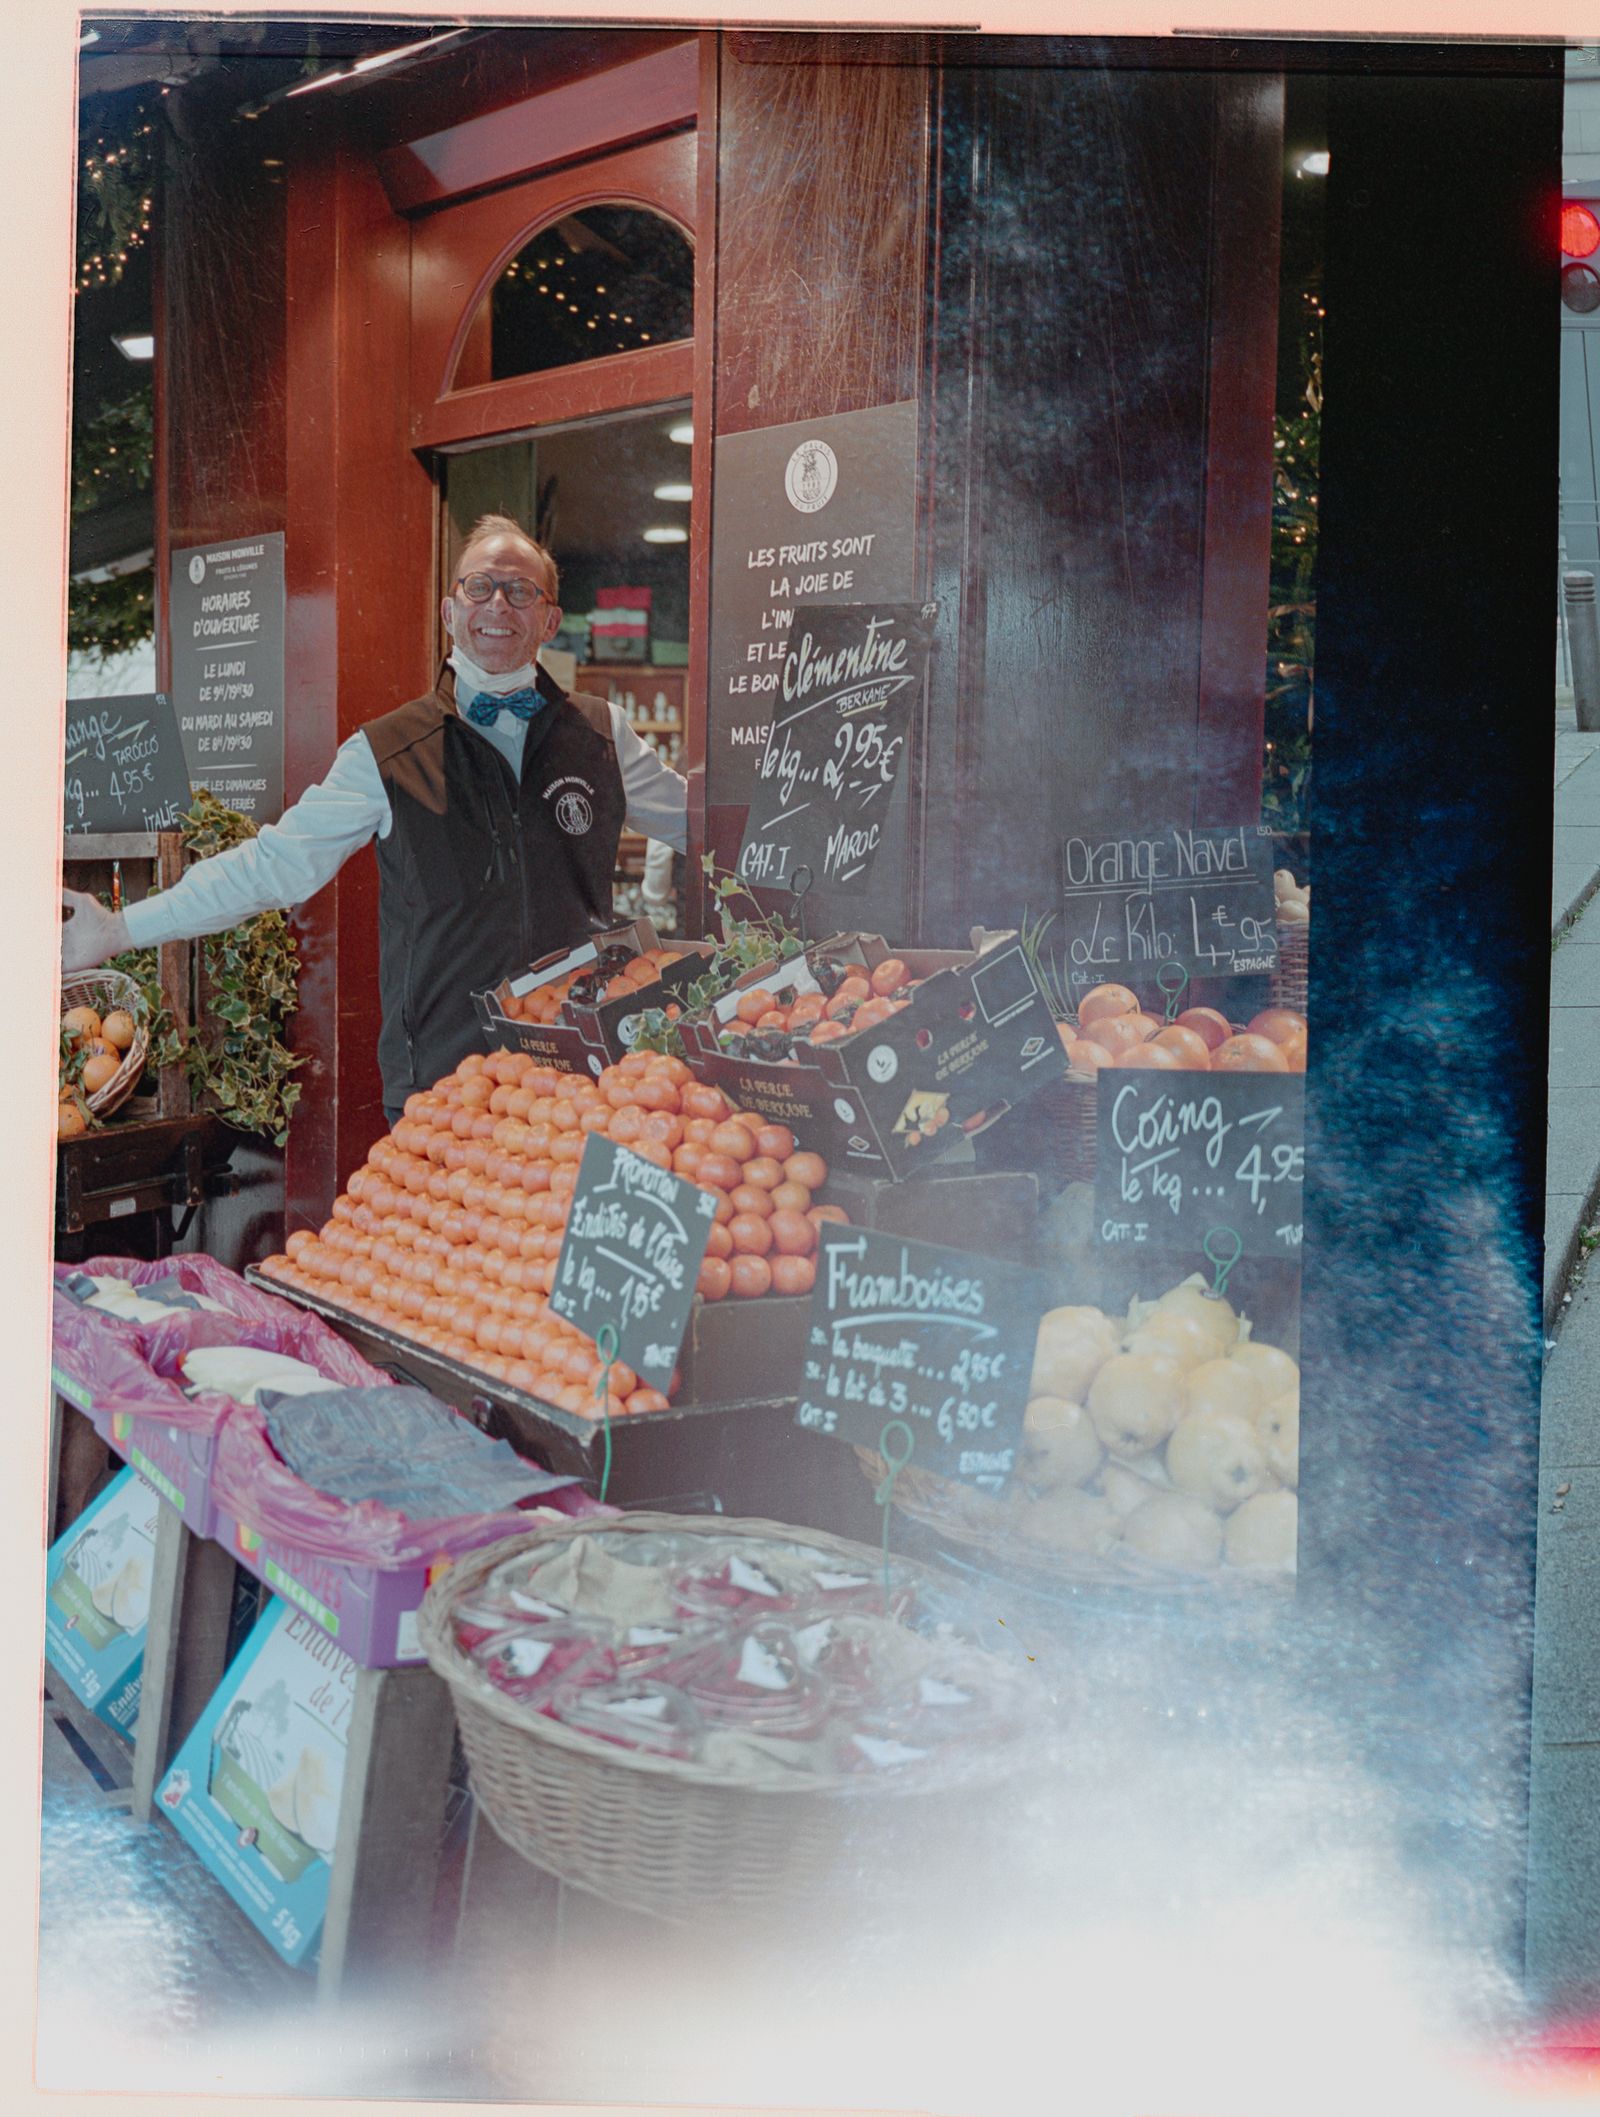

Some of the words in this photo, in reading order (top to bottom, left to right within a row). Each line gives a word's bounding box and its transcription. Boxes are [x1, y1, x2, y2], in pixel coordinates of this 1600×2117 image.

[206, 551, 231, 563] MAISON
[232, 544, 264, 558] MONVILLE
[748, 547, 775, 568] LES
[779, 541, 828, 567] FRUITS
[832, 534, 875, 559] SONT
[770, 578, 790, 598] LA
[794, 573, 828, 595] JOIE
[833, 570, 854, 590] DE
[201, 590, 251, 613] HORAIRES
[193, 613, 260, 637] D'OUVERTURE
[747, 642, 766, 662] ET
[768, 641, 787, 660] LE
[783, 616, 908, 703] Clémentine
[204, 664, 216, 679] LE
[218, 661, 247, 676] LUNDI
[200, 686, 210, 701] DE
[728, 674, 749, 695] LE
[182, 716, 193, 731] DU
[196, 714, 222, 731] MARDI
[224, 712, 237, 730] AU
[239, 710, 273, 728] SAMEDI
[112, 734, 159, 766] TAROCCO
[198, 736, 210, 752] DE
[761, 719, 780, 779] le
[823, 722, 903, 800] 2,95€
[110, 762, 154, 815] 4,95€
[211, 779, 224, 791] LES
[226, 779, 267, 792] DIMANCHES
[542, 778, 565, 799] MAISON
[824, 824, 881, 881] MAROC
[1174, 827, 1248, 876] Navel
[1234, 955, 1277, 973] ESPAGNE
[519, 1037, 530, 1050] LA
[530, 1040, 559, 1054] PERLE
[739, 1077, 753, 1092] LA
[754, 1080, 794, 1098] PERLE
[755, 1099, 813, 1118] BERKANE
[1112, 1085, 1232, 1168] Coing
[1121, 1157, 1143, 1203] le
[825, 1235, 986, 1317] Framboises
